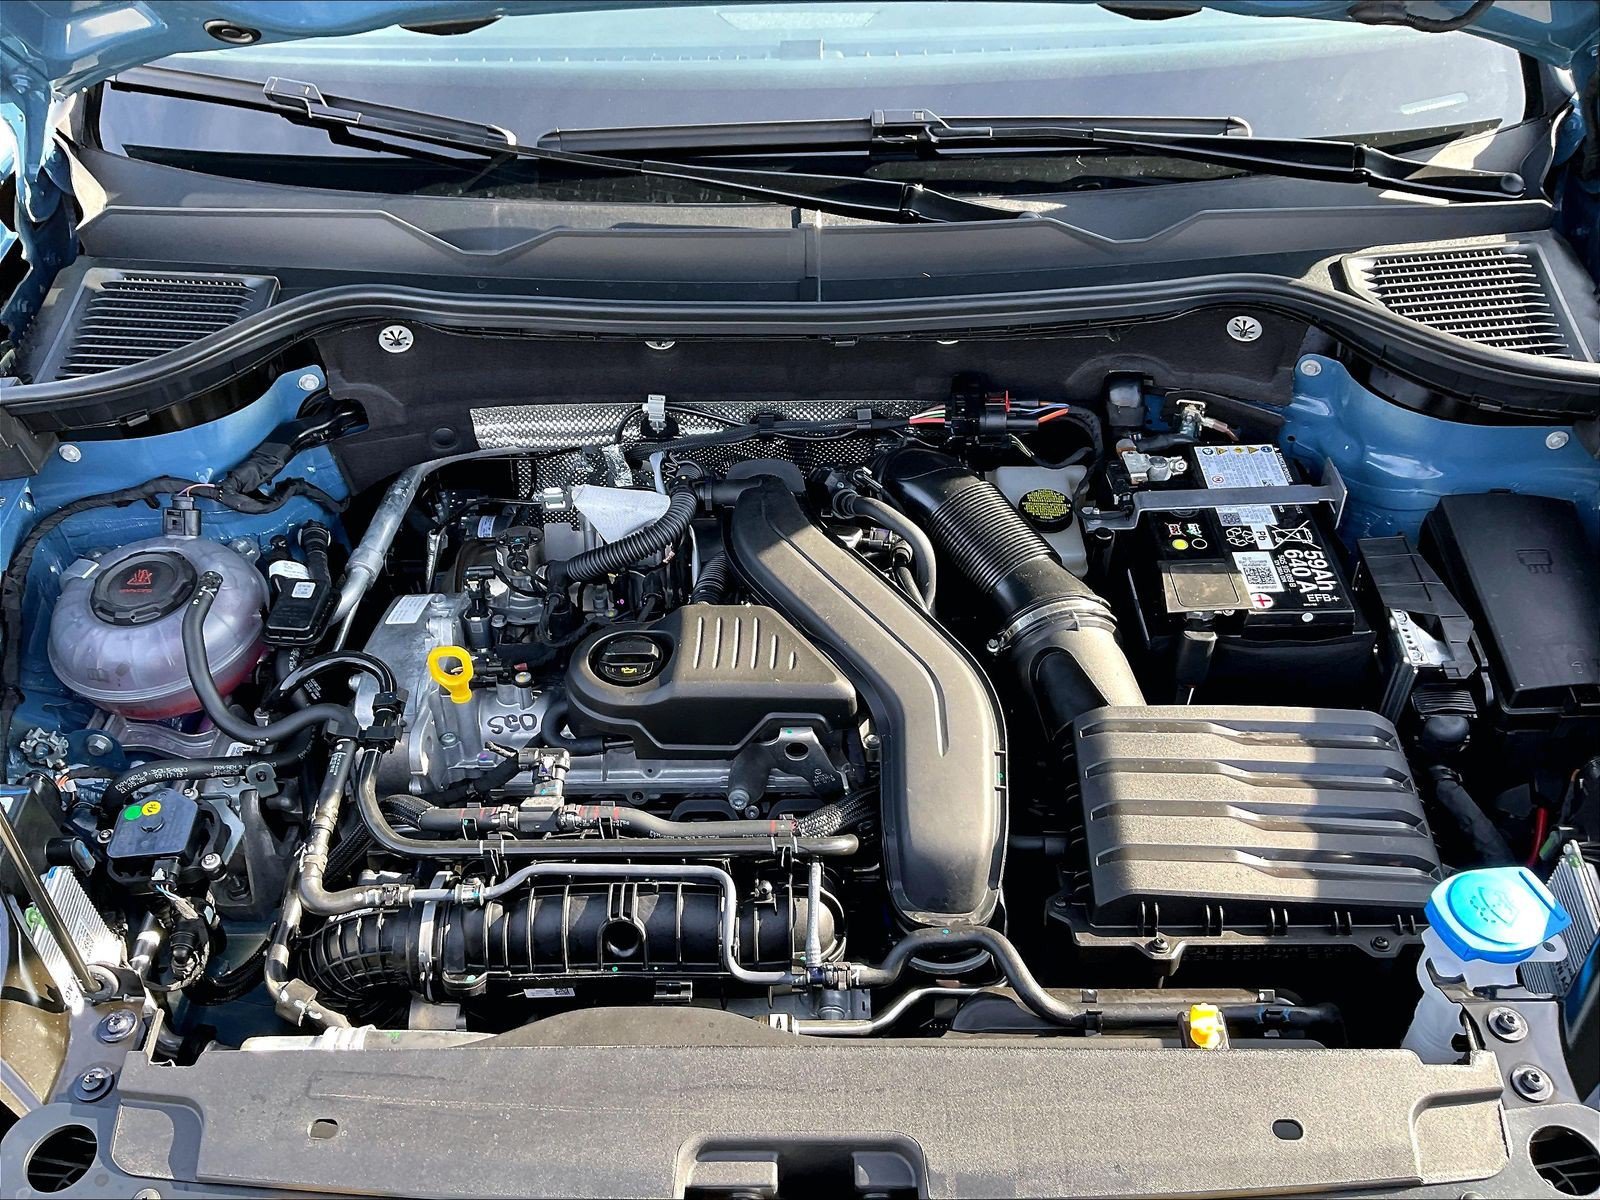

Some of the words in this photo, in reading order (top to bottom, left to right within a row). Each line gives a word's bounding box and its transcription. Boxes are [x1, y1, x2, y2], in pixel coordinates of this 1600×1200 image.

[1255, 531, 1268, 541] Pb
[1284, 549, 1312, 577] 640
[1303, 550, 1338, 591] 59Ah
[1295, 580, 1318, 594] A
[1306, 593, 1341, 603] EFB+
